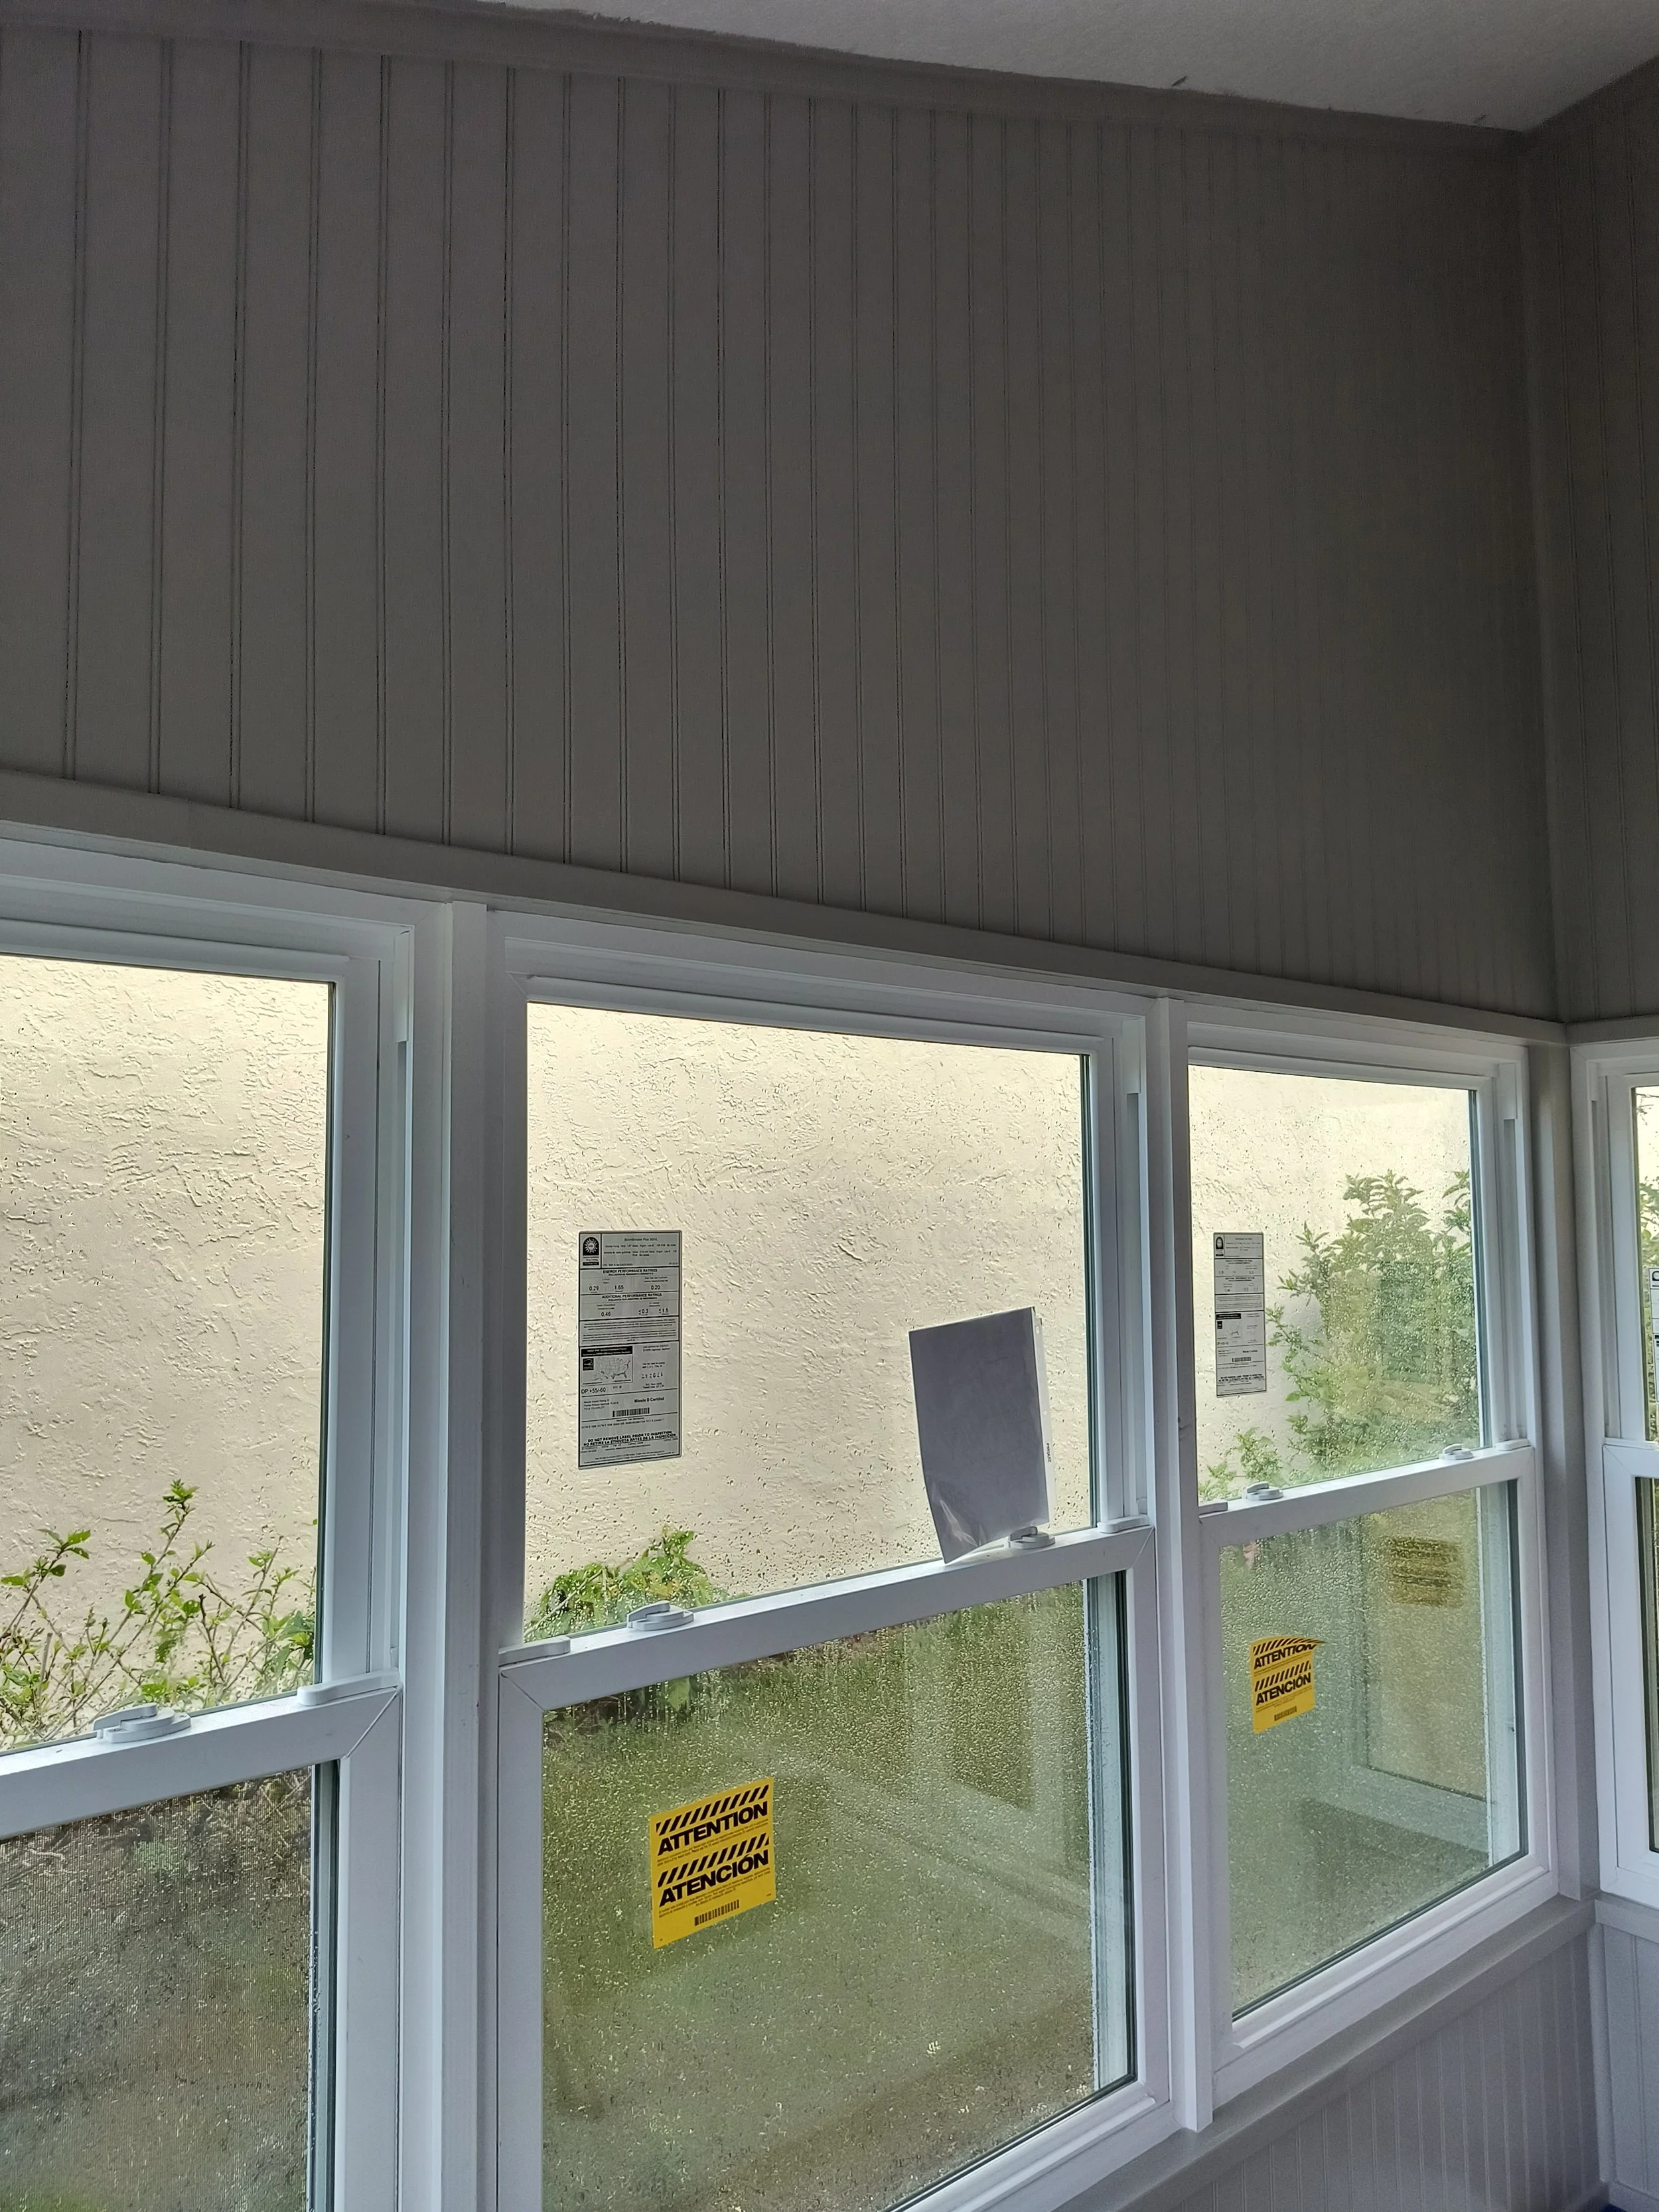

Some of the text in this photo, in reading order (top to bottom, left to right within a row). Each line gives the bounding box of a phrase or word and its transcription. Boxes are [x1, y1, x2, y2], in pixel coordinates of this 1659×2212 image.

[1254, 1644, 1317, 1670] ATTENTION
[1256, 1672, 1311, 1706] ATENCIÓN
[658, 1801, 768, 1856] ATTENTION
[659, 1849, 769, 1907] ATENCIÓN
